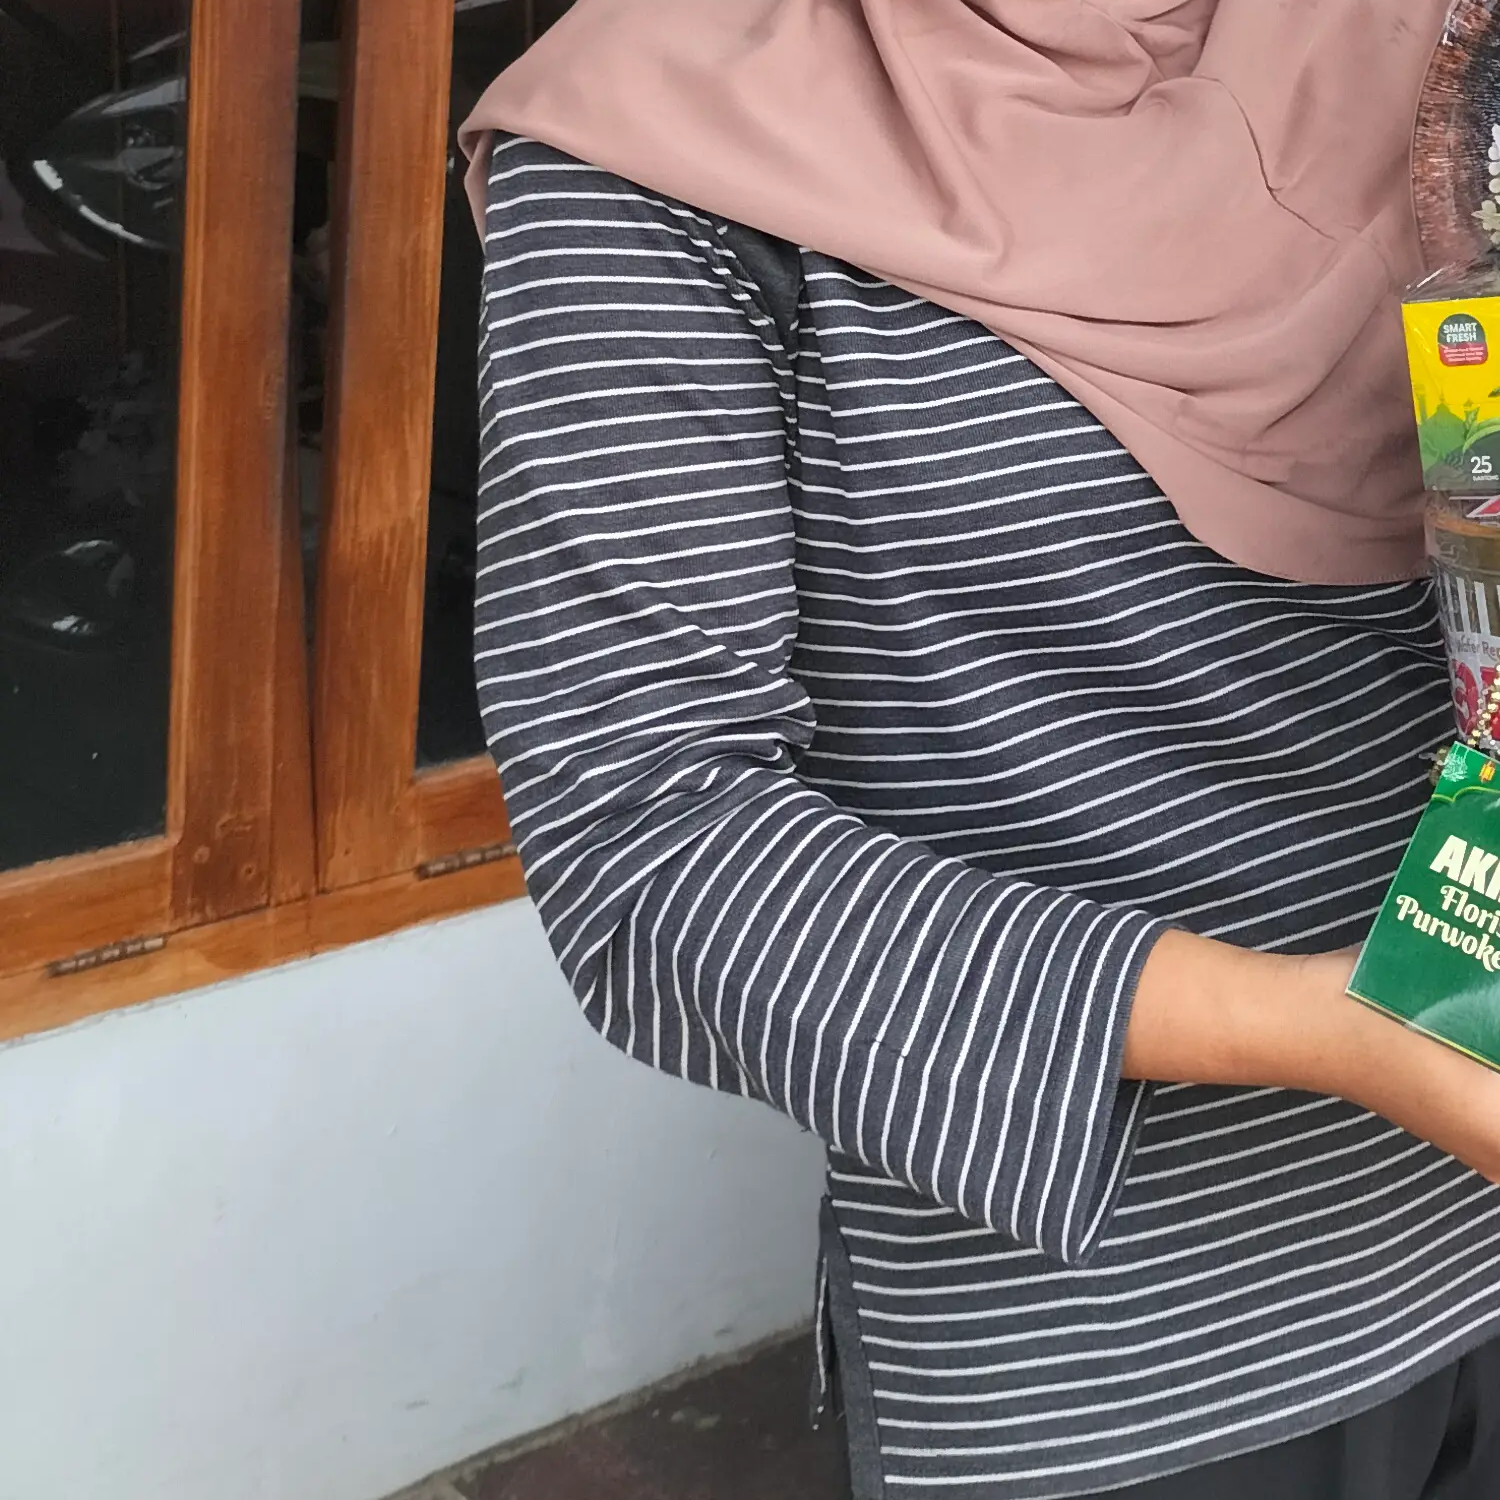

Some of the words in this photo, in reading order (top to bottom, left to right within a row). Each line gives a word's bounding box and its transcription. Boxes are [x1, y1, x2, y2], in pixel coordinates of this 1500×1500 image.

[1443, 322, 1477, 334] SMART
[1446, 332, 1477, 343] FRESH
[1470, 455, 1493, 474] 25
